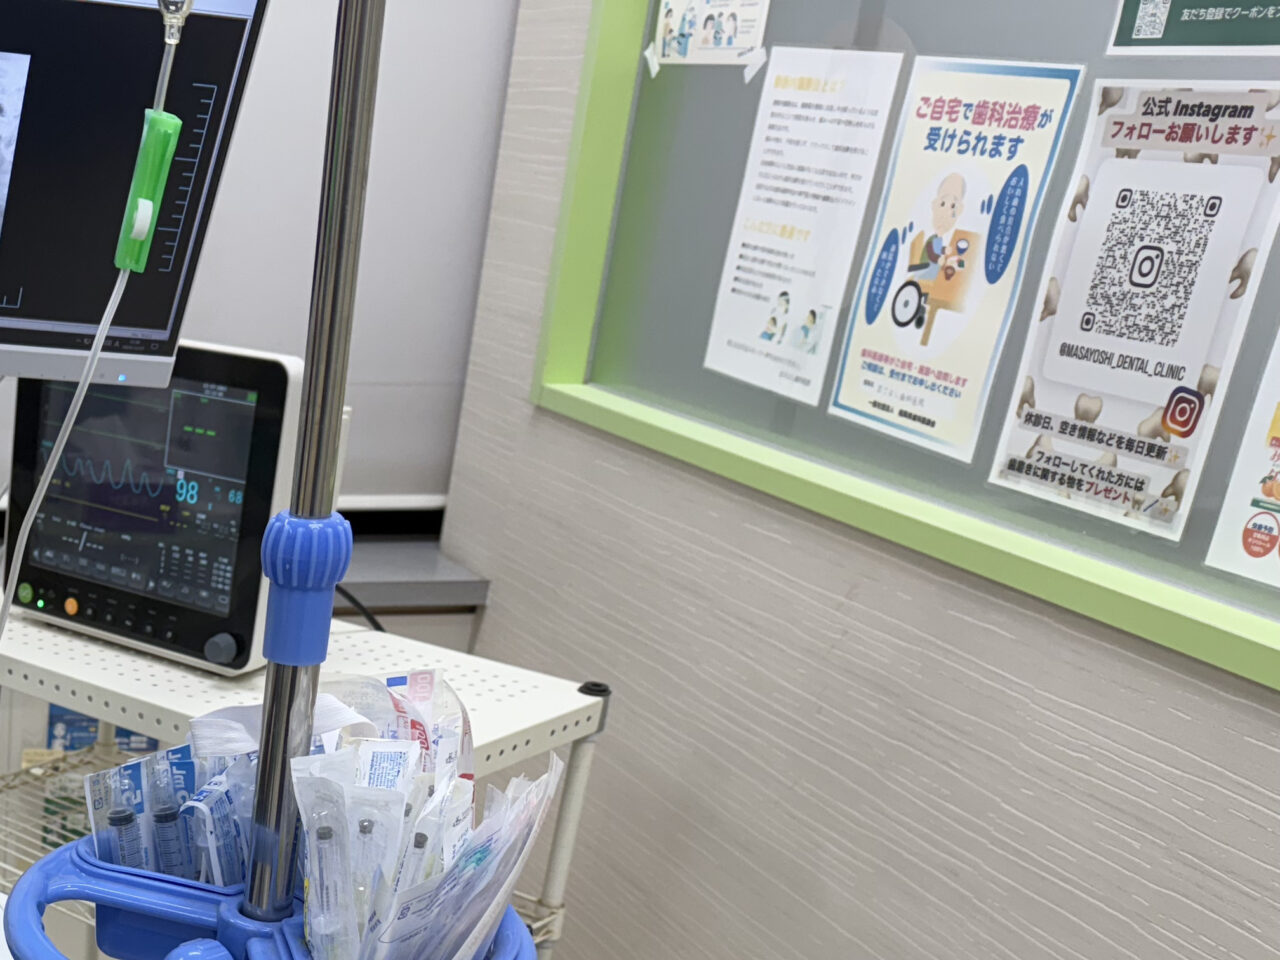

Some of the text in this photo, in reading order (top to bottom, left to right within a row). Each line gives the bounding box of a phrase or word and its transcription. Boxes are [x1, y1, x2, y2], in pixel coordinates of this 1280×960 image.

[916, 96, 1055, 131] ご自宅で歯科治療が
[1141, 96, 1255, 123] 公式 Instagram
[923, 126, 1025, 161] 受けられます
[1111, 120, 1259, 146] フォローお願いします
[1059, 342, 1187, 381] @MASAYOSHI_DENTAL_CLINIC
[1023, 412, 1168, 461] 休診日、空き情報などを毎日更新
[1007, 458, 1131, 504] 歯磨きに関する物をプレゼント
[1036, 450, 1146, 492] フォローしてくれた方には
[176, 479, 199, 505] 98
[228, 489, 243, 505] 68
